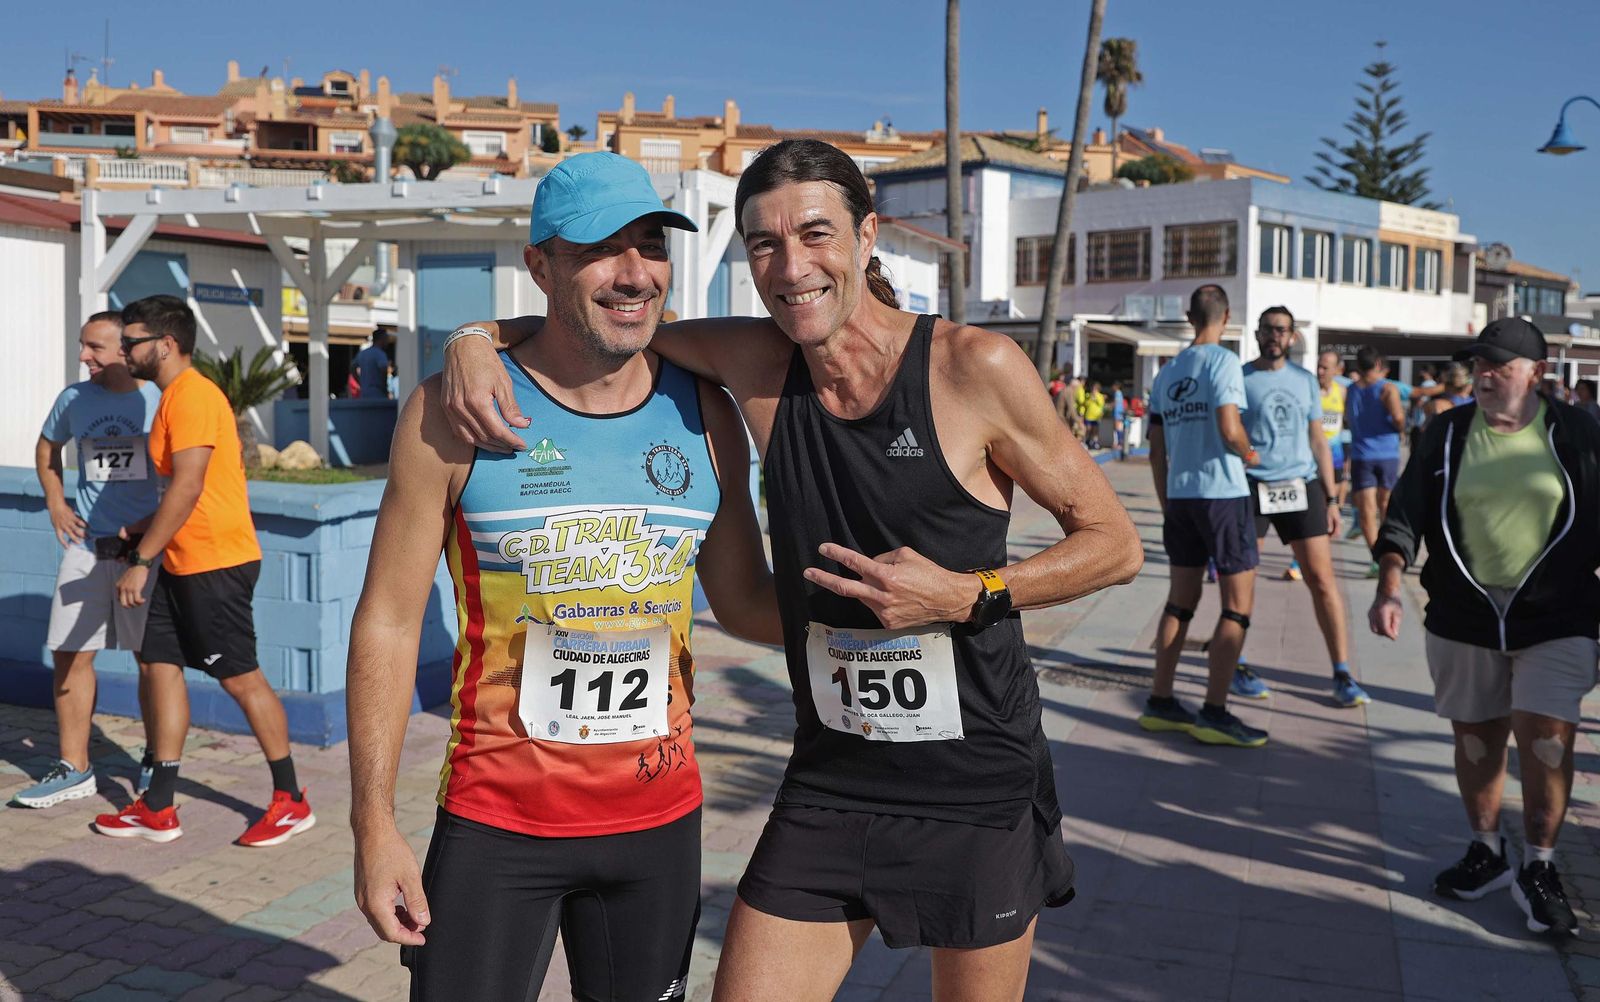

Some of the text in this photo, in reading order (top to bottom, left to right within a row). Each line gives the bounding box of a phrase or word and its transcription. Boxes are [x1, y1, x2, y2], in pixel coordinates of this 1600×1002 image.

[534, 449, 556, 462] FAM
[886, 446, 924, 457] adidas
[93, 452, 134, 468] 127
[521, 481, 571, 489] #DONAMÉDULA
[1268, 490, 1297, 503] 246
[504, 516, 642, 558] C.D. TRAIL
[529, 553, 620, 586] TEAM
[554, 599, 682, 619] Gabarras & Servicios
[553, 637, 651, 652] CARRERA URBANA
[553, 649, 651, 664] CIUDAD DE ALGECIRAS
[828, 647, 922, 662] CIUDAD DE ALGECIRAS
[550, 668, 649, 712] 112
[831, 666, 928, 711] 150
